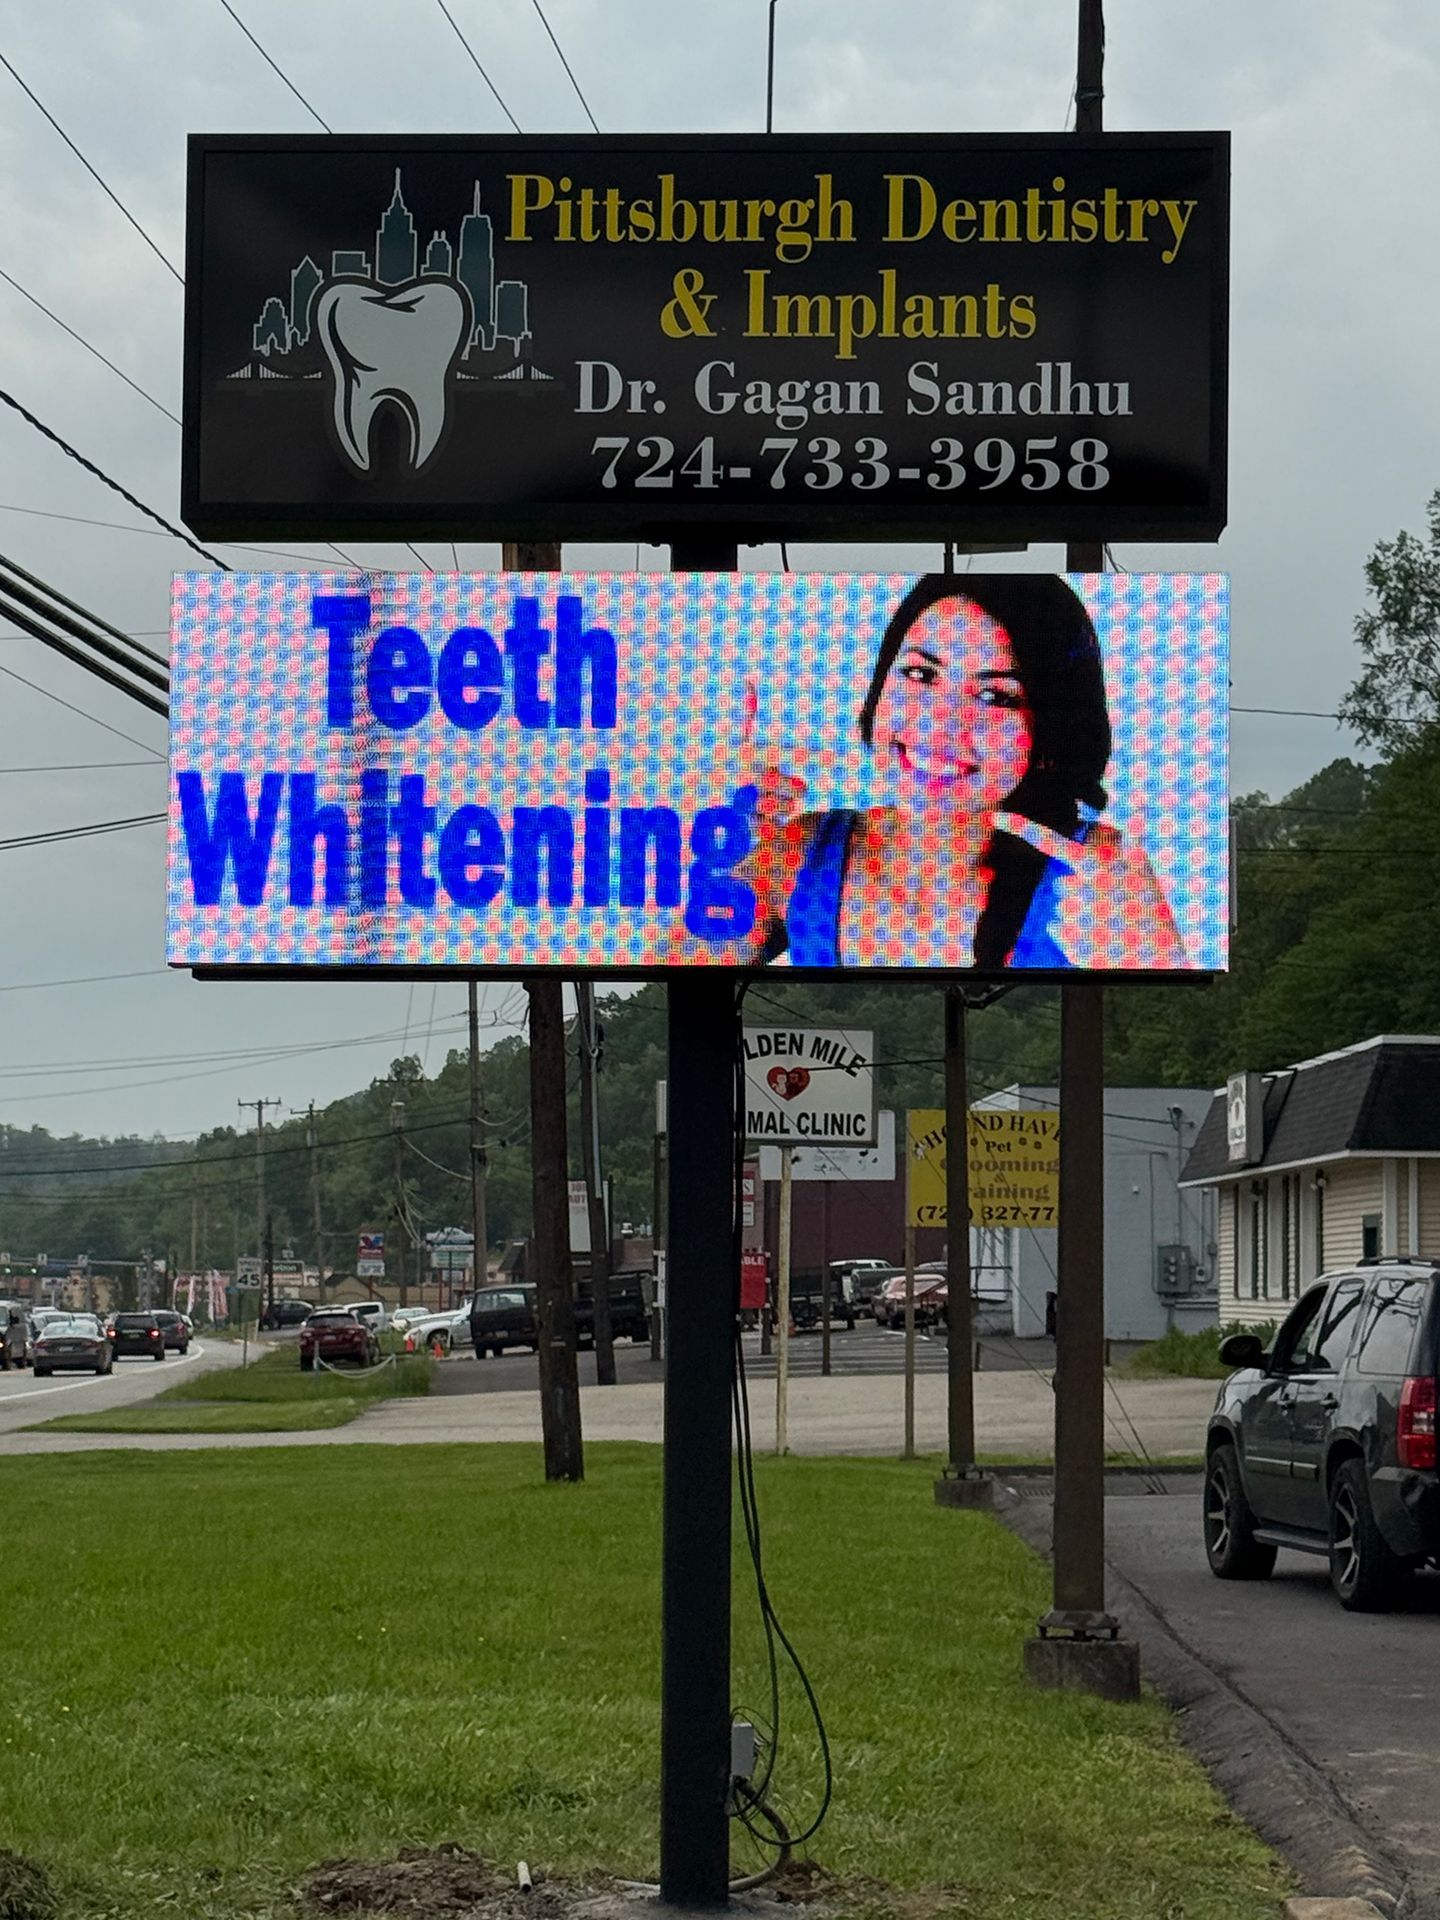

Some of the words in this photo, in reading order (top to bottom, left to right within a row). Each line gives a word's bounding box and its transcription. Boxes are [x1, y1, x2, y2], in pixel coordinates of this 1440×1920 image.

[506, 175, 856, 263] Pittsburgh
[880, 175, 1197, 264] Dentistry
[660, 269, 713, 338] &
[743, 269, 1036, 359] Implants
[575, 361, 666, 415] Dr.
[695, 360, 883, 430] Gagan
[907, 361, 1134, 416] Sandhu
[591, 436, 1110, 491] 724-733-3958
[311, 595, 617, 730] Teeth
[177, 768, 759, 941] Whitening
[809, 1036, 867, 1078] MILE
[796, 1111, 866, 1136] CLINIC
[984, 1140, 1012, 1153] Pet
[939, 1157, 1060, 1176] ooming
[238, 1274, 260, 1286] 45
